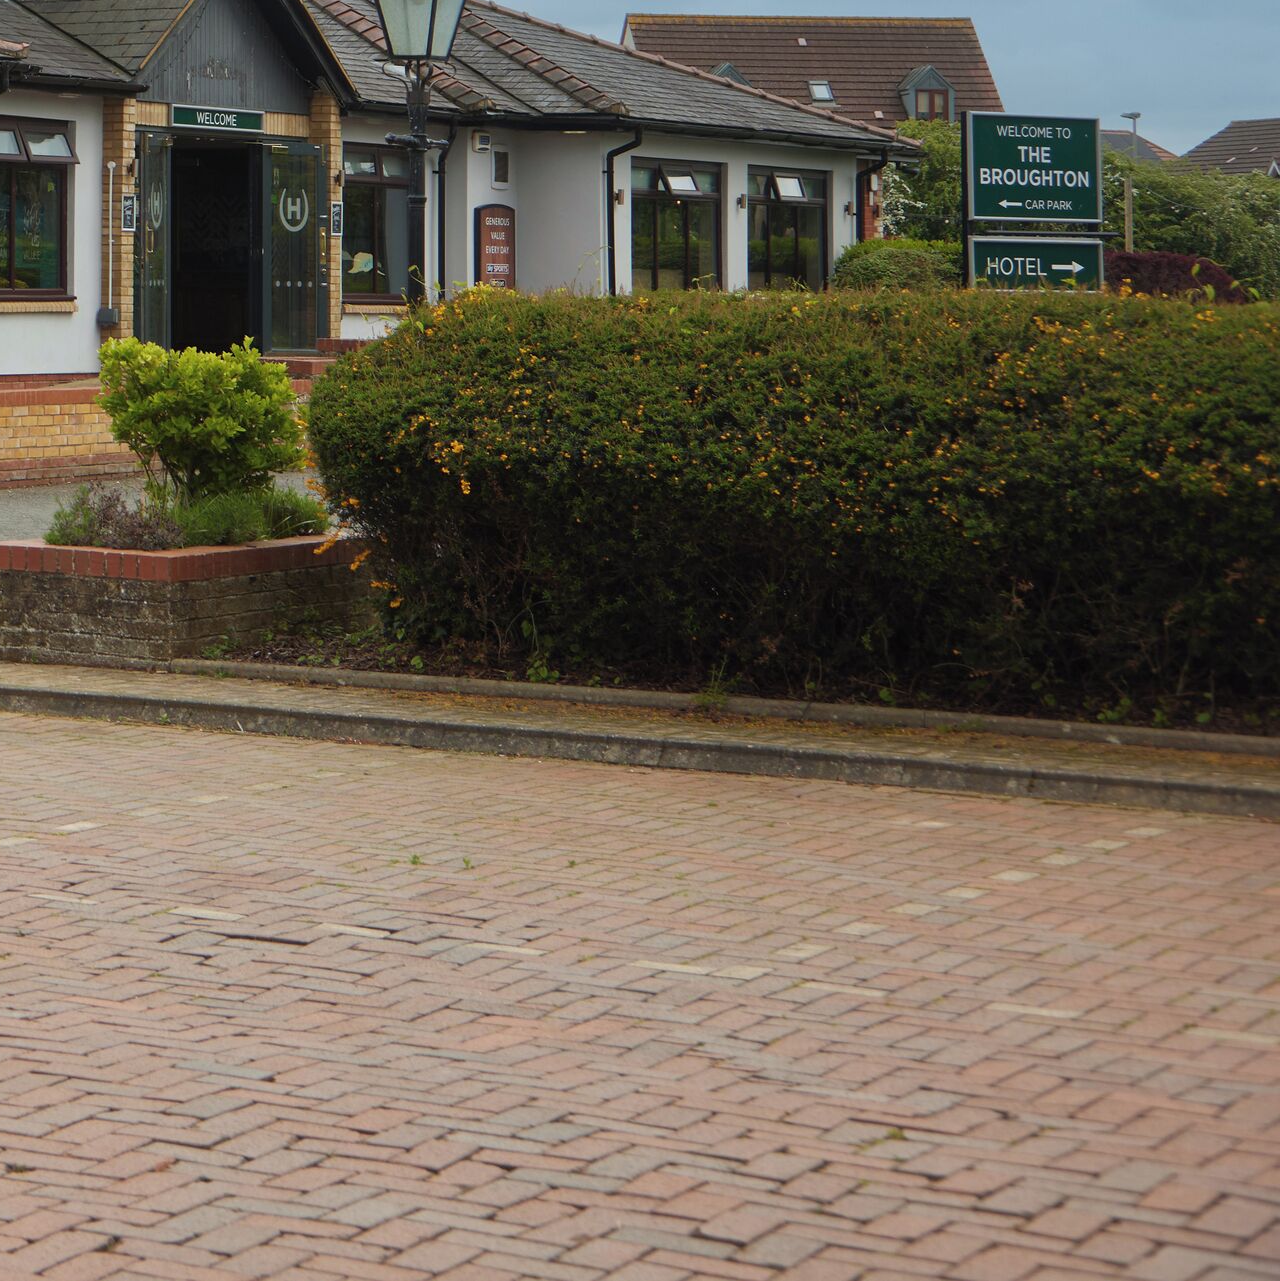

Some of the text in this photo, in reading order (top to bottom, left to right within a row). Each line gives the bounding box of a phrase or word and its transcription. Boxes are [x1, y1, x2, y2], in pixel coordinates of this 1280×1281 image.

[196, 111, 237, 126] WELCOME
[996, 125, 1071, 139] WELCOME TO
[1017, 145, 1052, 164] THE
[980, 168, 1089, 188] BROUGHTON
[1025, 200, 1073, 211] CAR PARK
[485, 217, 510, 226] GENEROUS
[490, 231, 505, 240] VALUE
[485, 245, 509, 254] EVERY DAY
[987, 257, 1047, 276] HOTEL
